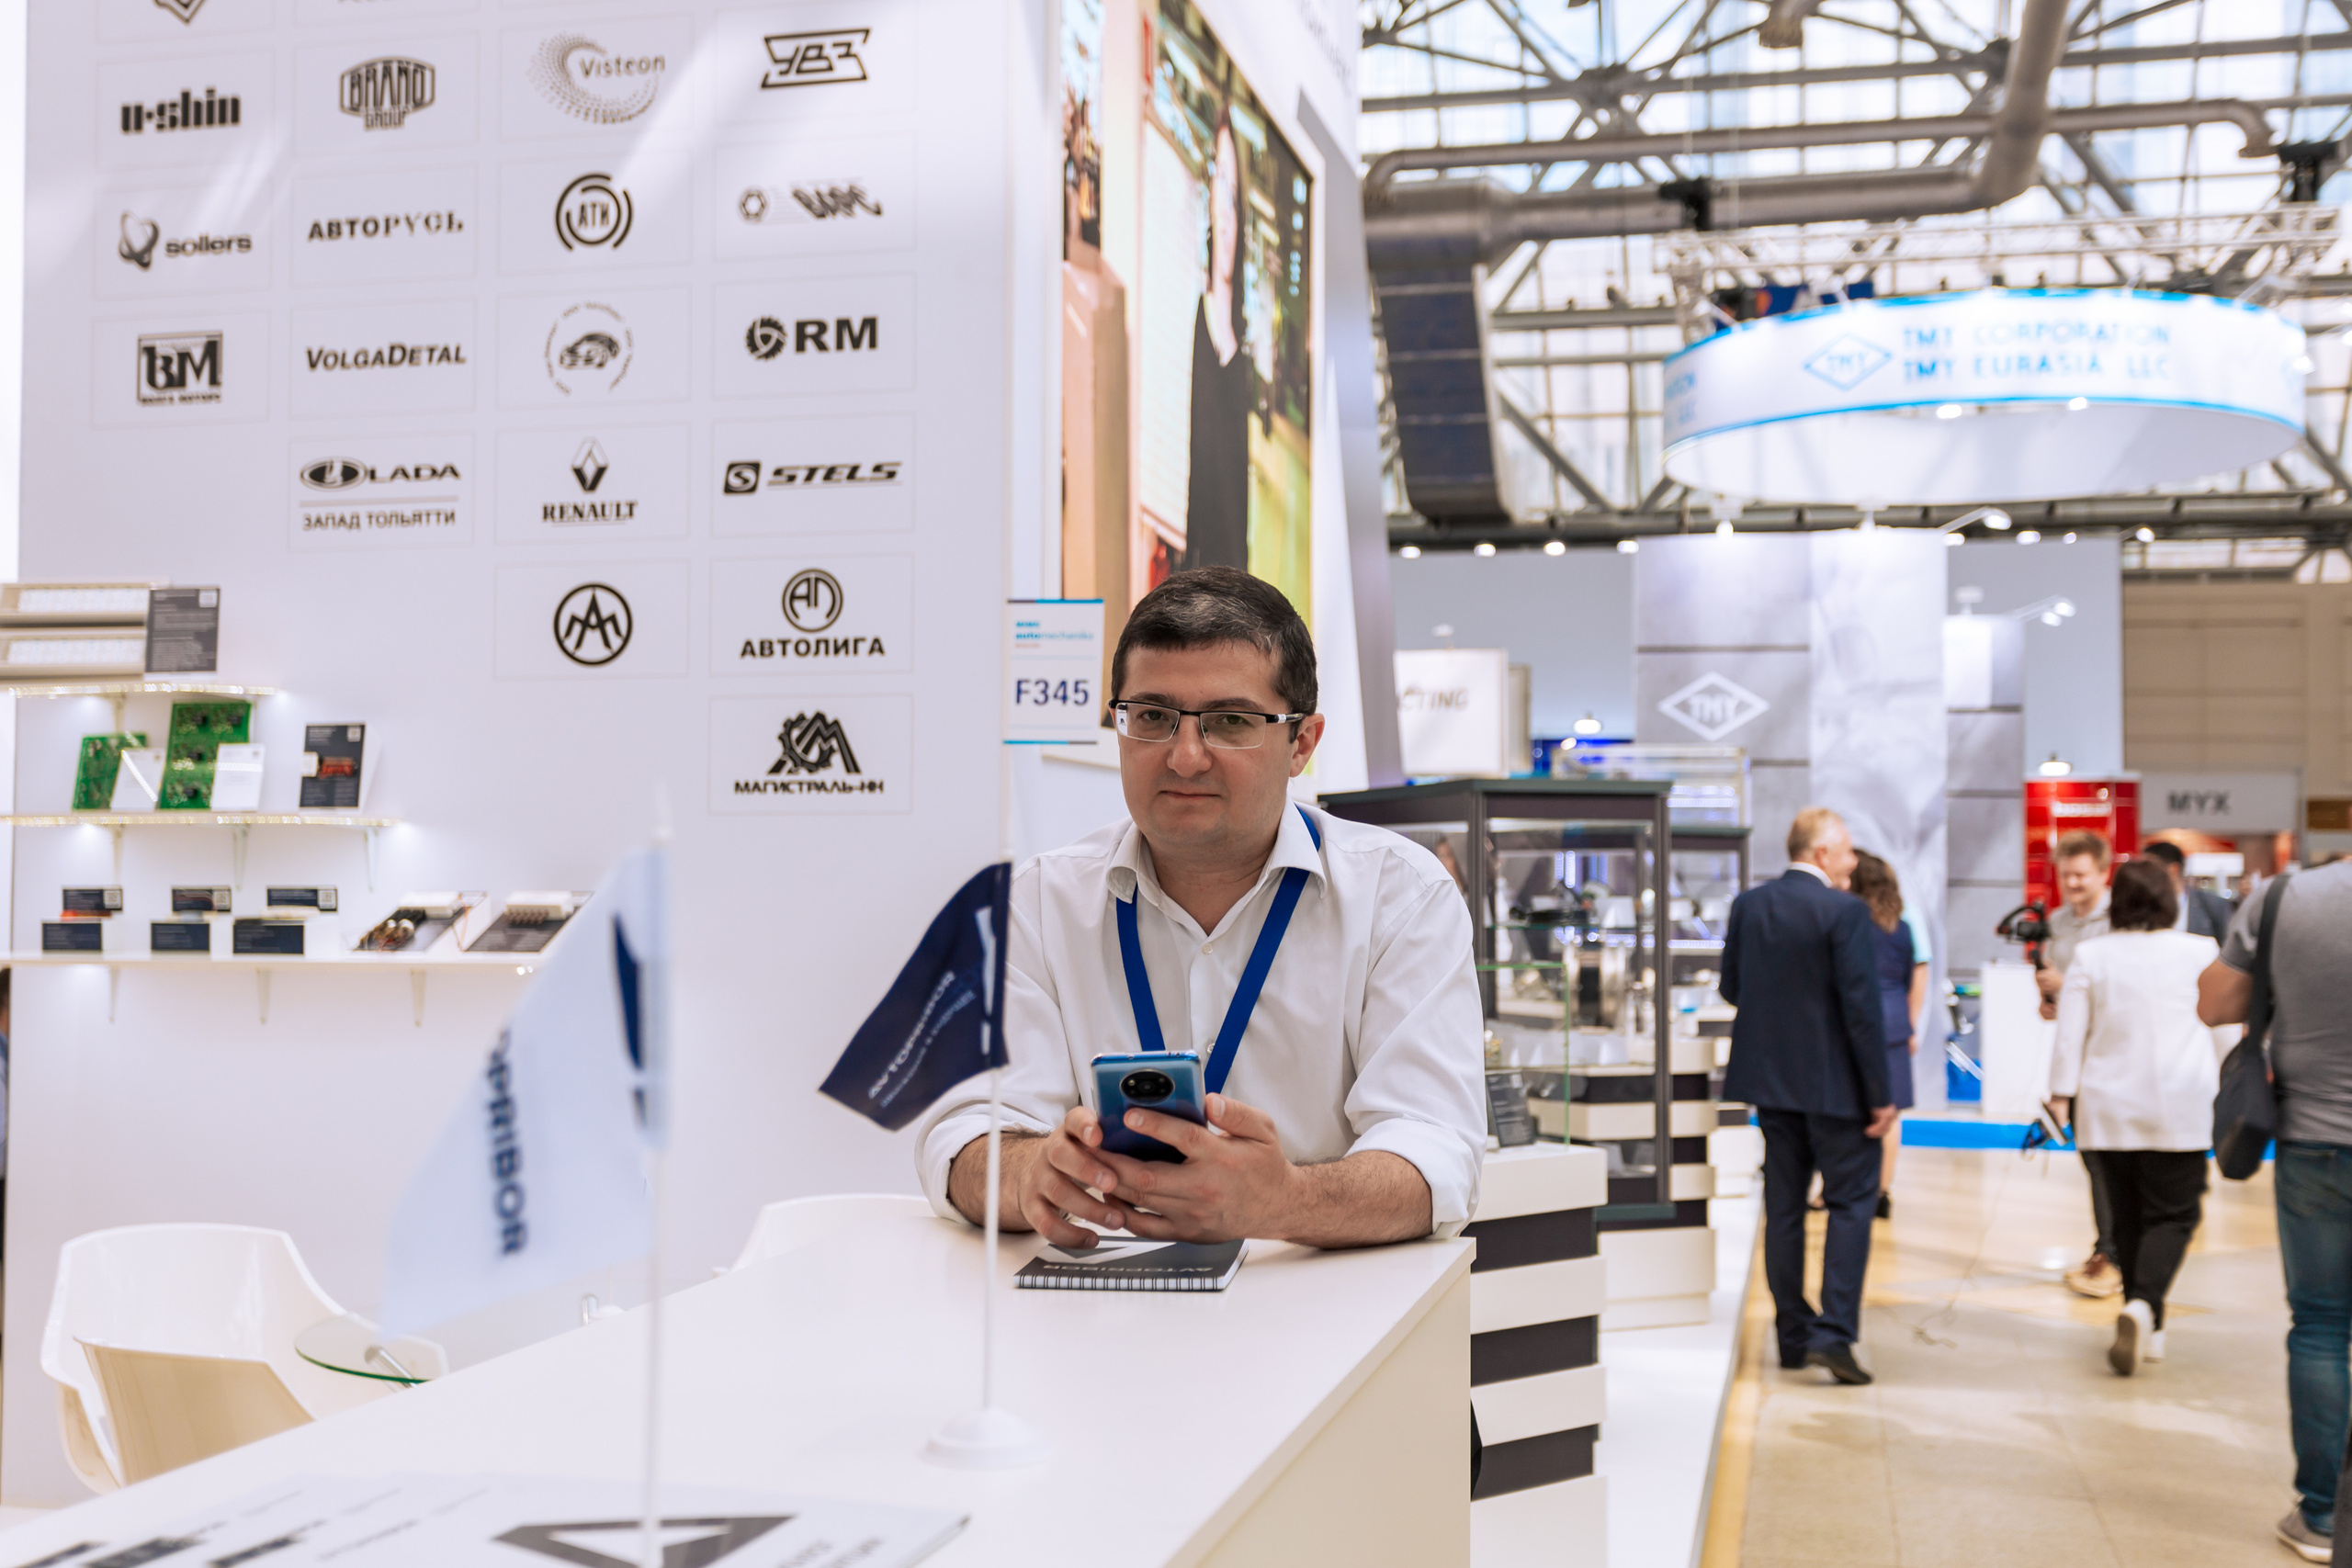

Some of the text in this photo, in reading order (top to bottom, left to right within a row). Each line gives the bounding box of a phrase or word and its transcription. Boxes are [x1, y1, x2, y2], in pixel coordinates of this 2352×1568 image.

[580, 54, 665, 78] Visteon
[307, 210, 464, 242] АВТОРУСЬ
[165, 233, 253, 257] sollers
[1973, 321, 2171, 345] CORPORATION
[1973, 354, 2104, 379] EURASIA
[2127, 355, 2170, 379] LLC
[368, 463, 461, 484] LADA
[767, 461, 903, 488] STELS
[302, 509, 456, 532] ЗАПАД ТОЛЬЯТТИ
[542, 501, 639, 523] RENAULT
[740, 637, 886, 659] АВТОЛИГА
[1015, 679, 1090, 706] F345
[1396, 685, 1469, 711] CTING
[1687, 695, 1740, 725] TMY
[734, 780, 885, 795] МАГИСТРАЛЬ-НН
[1043, 1264, 1214, 1273] AVTOPRIBOR
